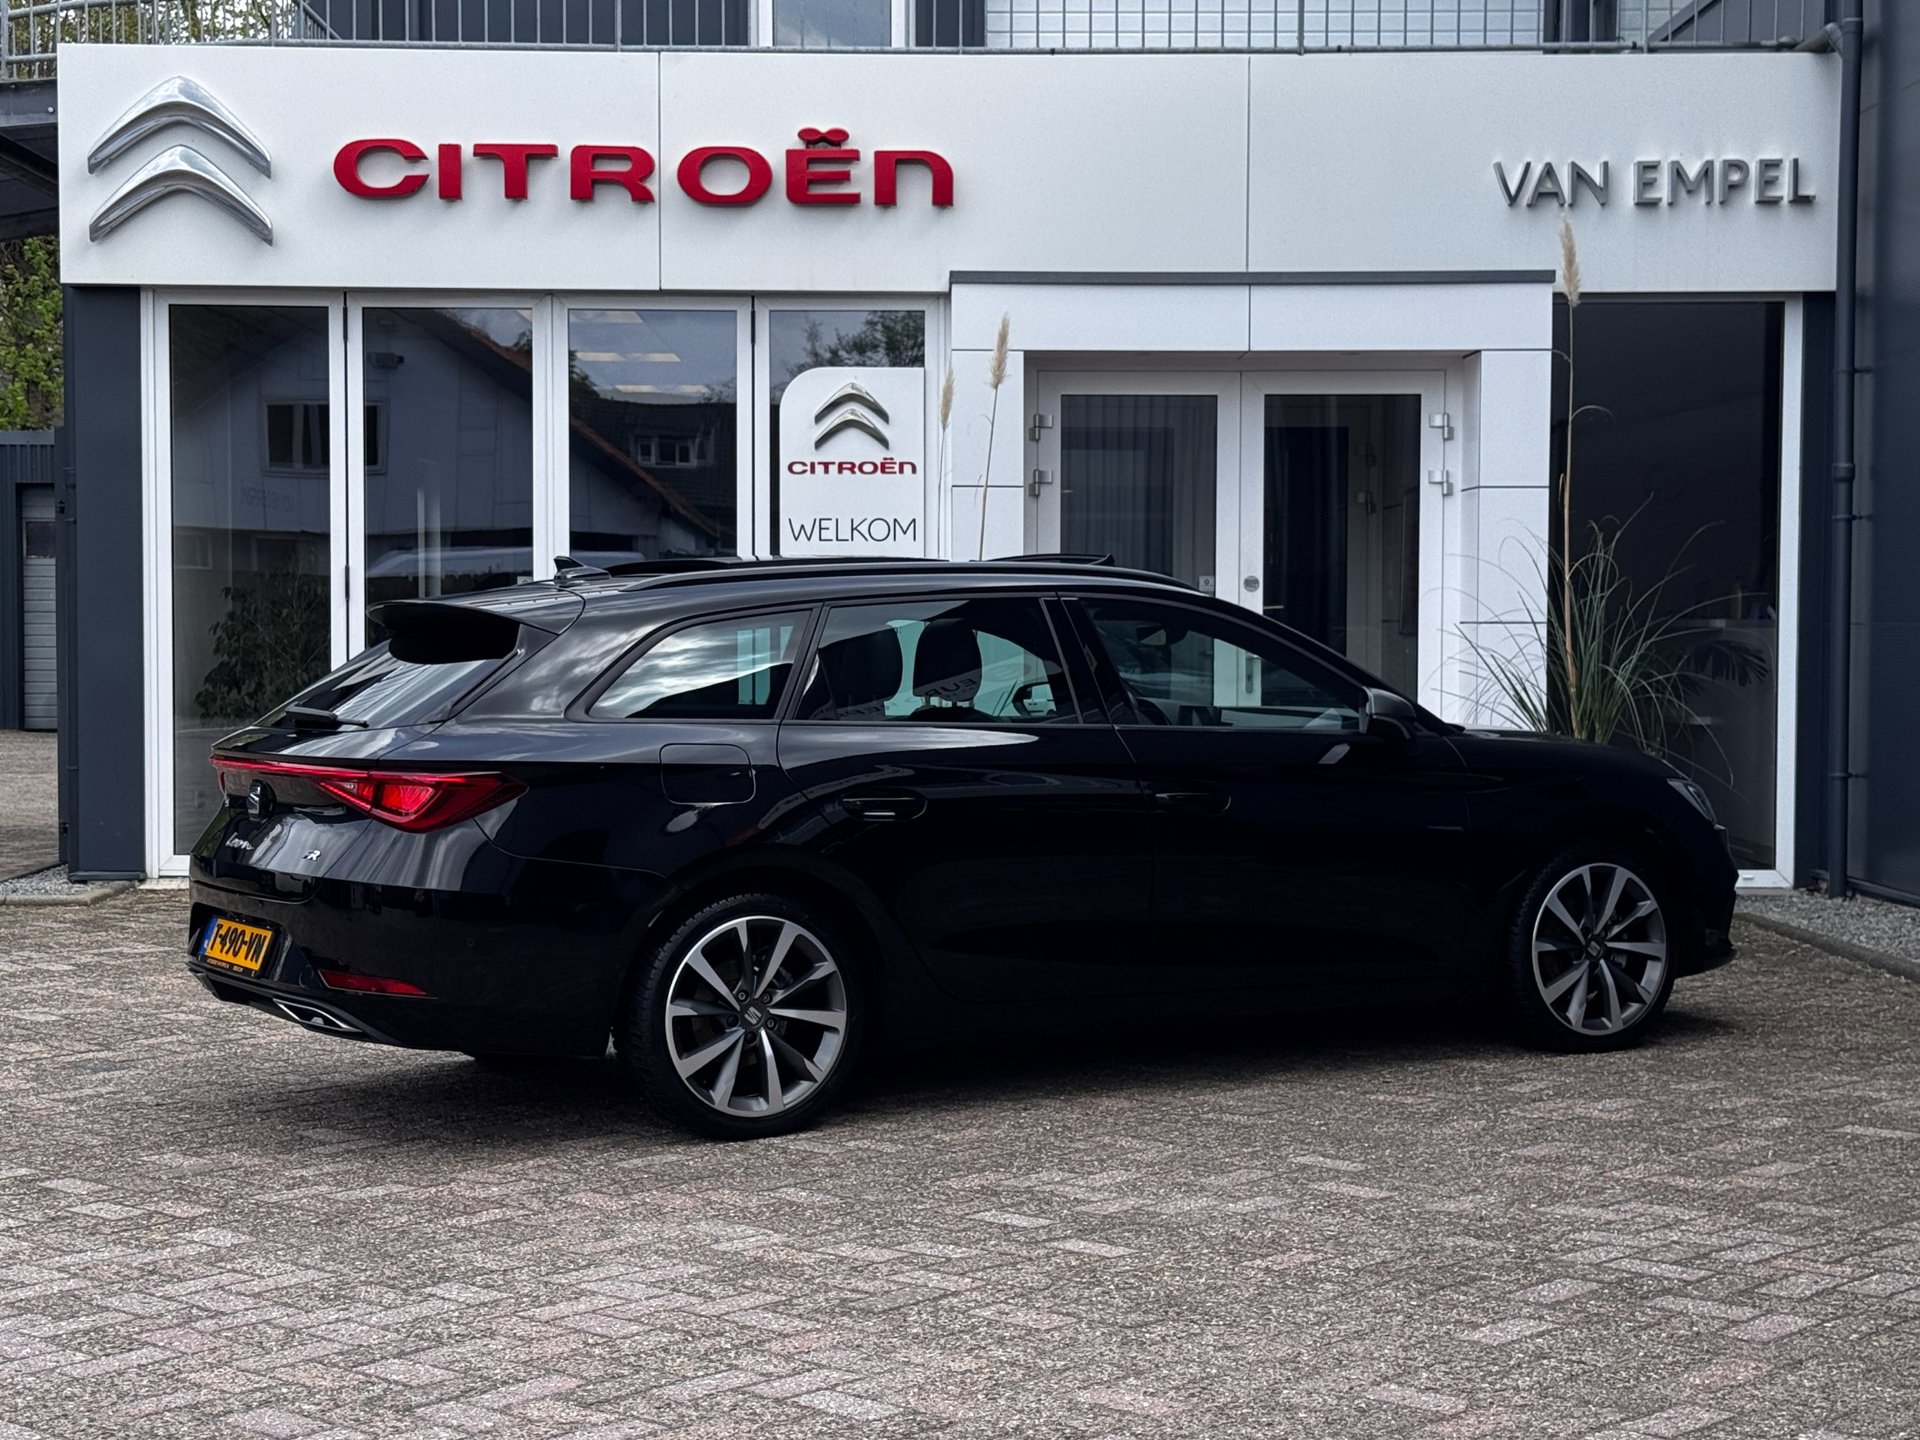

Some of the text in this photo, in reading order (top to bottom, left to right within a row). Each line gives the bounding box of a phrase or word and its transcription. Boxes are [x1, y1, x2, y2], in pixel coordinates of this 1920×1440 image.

[334, 128, 954, 207] CITROËN
[1494, 157, 1818, 208] VAN EMPEL
[787, 457, 917, 475] CITROËN
[788, 517, 917, 542] WELKOM
[209, 923, 268, 964] T-490-VN
